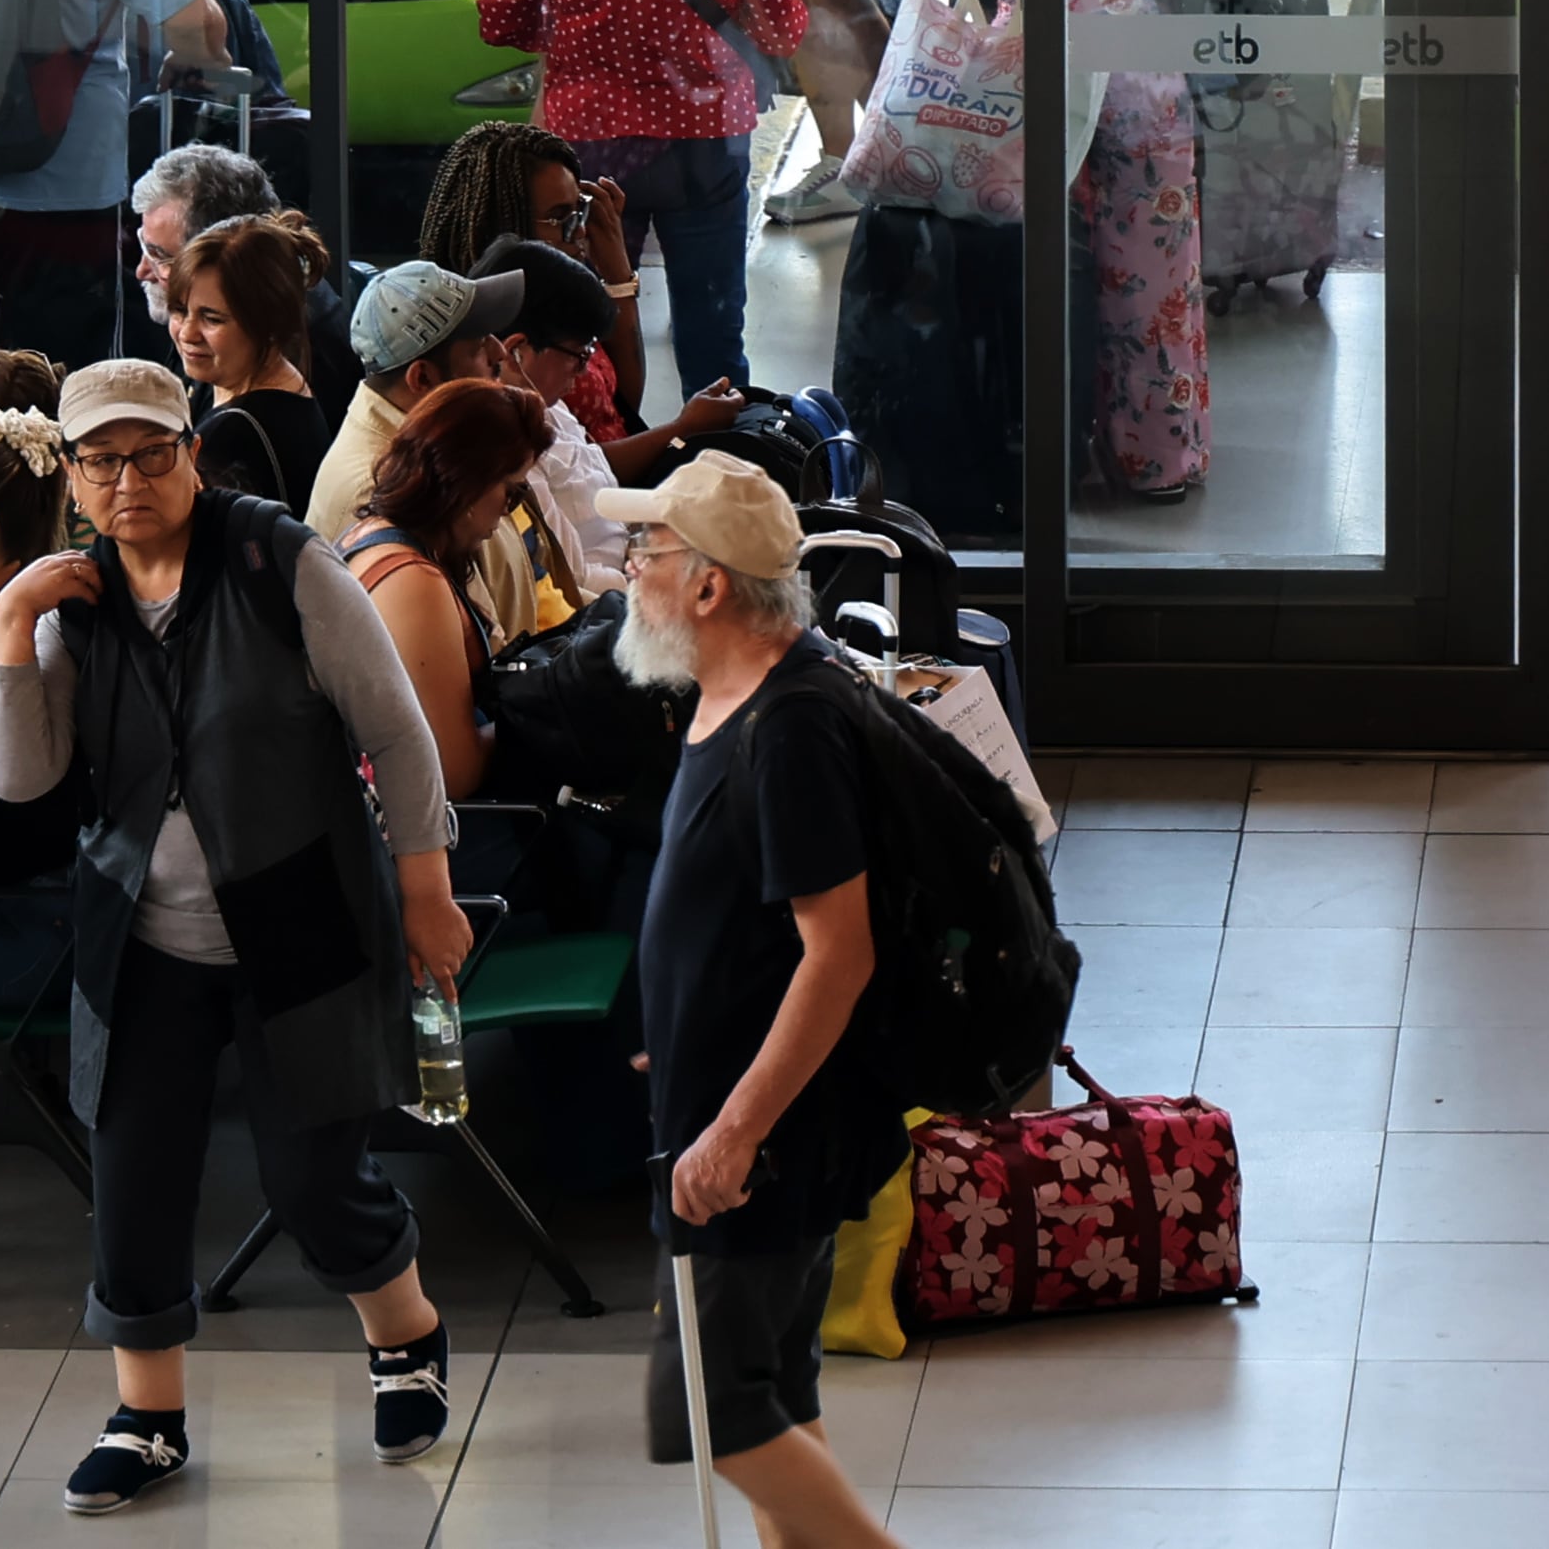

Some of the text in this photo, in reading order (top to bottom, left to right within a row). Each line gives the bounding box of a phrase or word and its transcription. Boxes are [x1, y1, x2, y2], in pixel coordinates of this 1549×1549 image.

[1192, 22, 1260, 65] etb
[1382, 23, 1445, 67] etb
[903, 58, 961, 90] Eduardo
[907, 76, 1015, 118] DURÁN
[921, 106, 1002, 133] DIPUTADO
